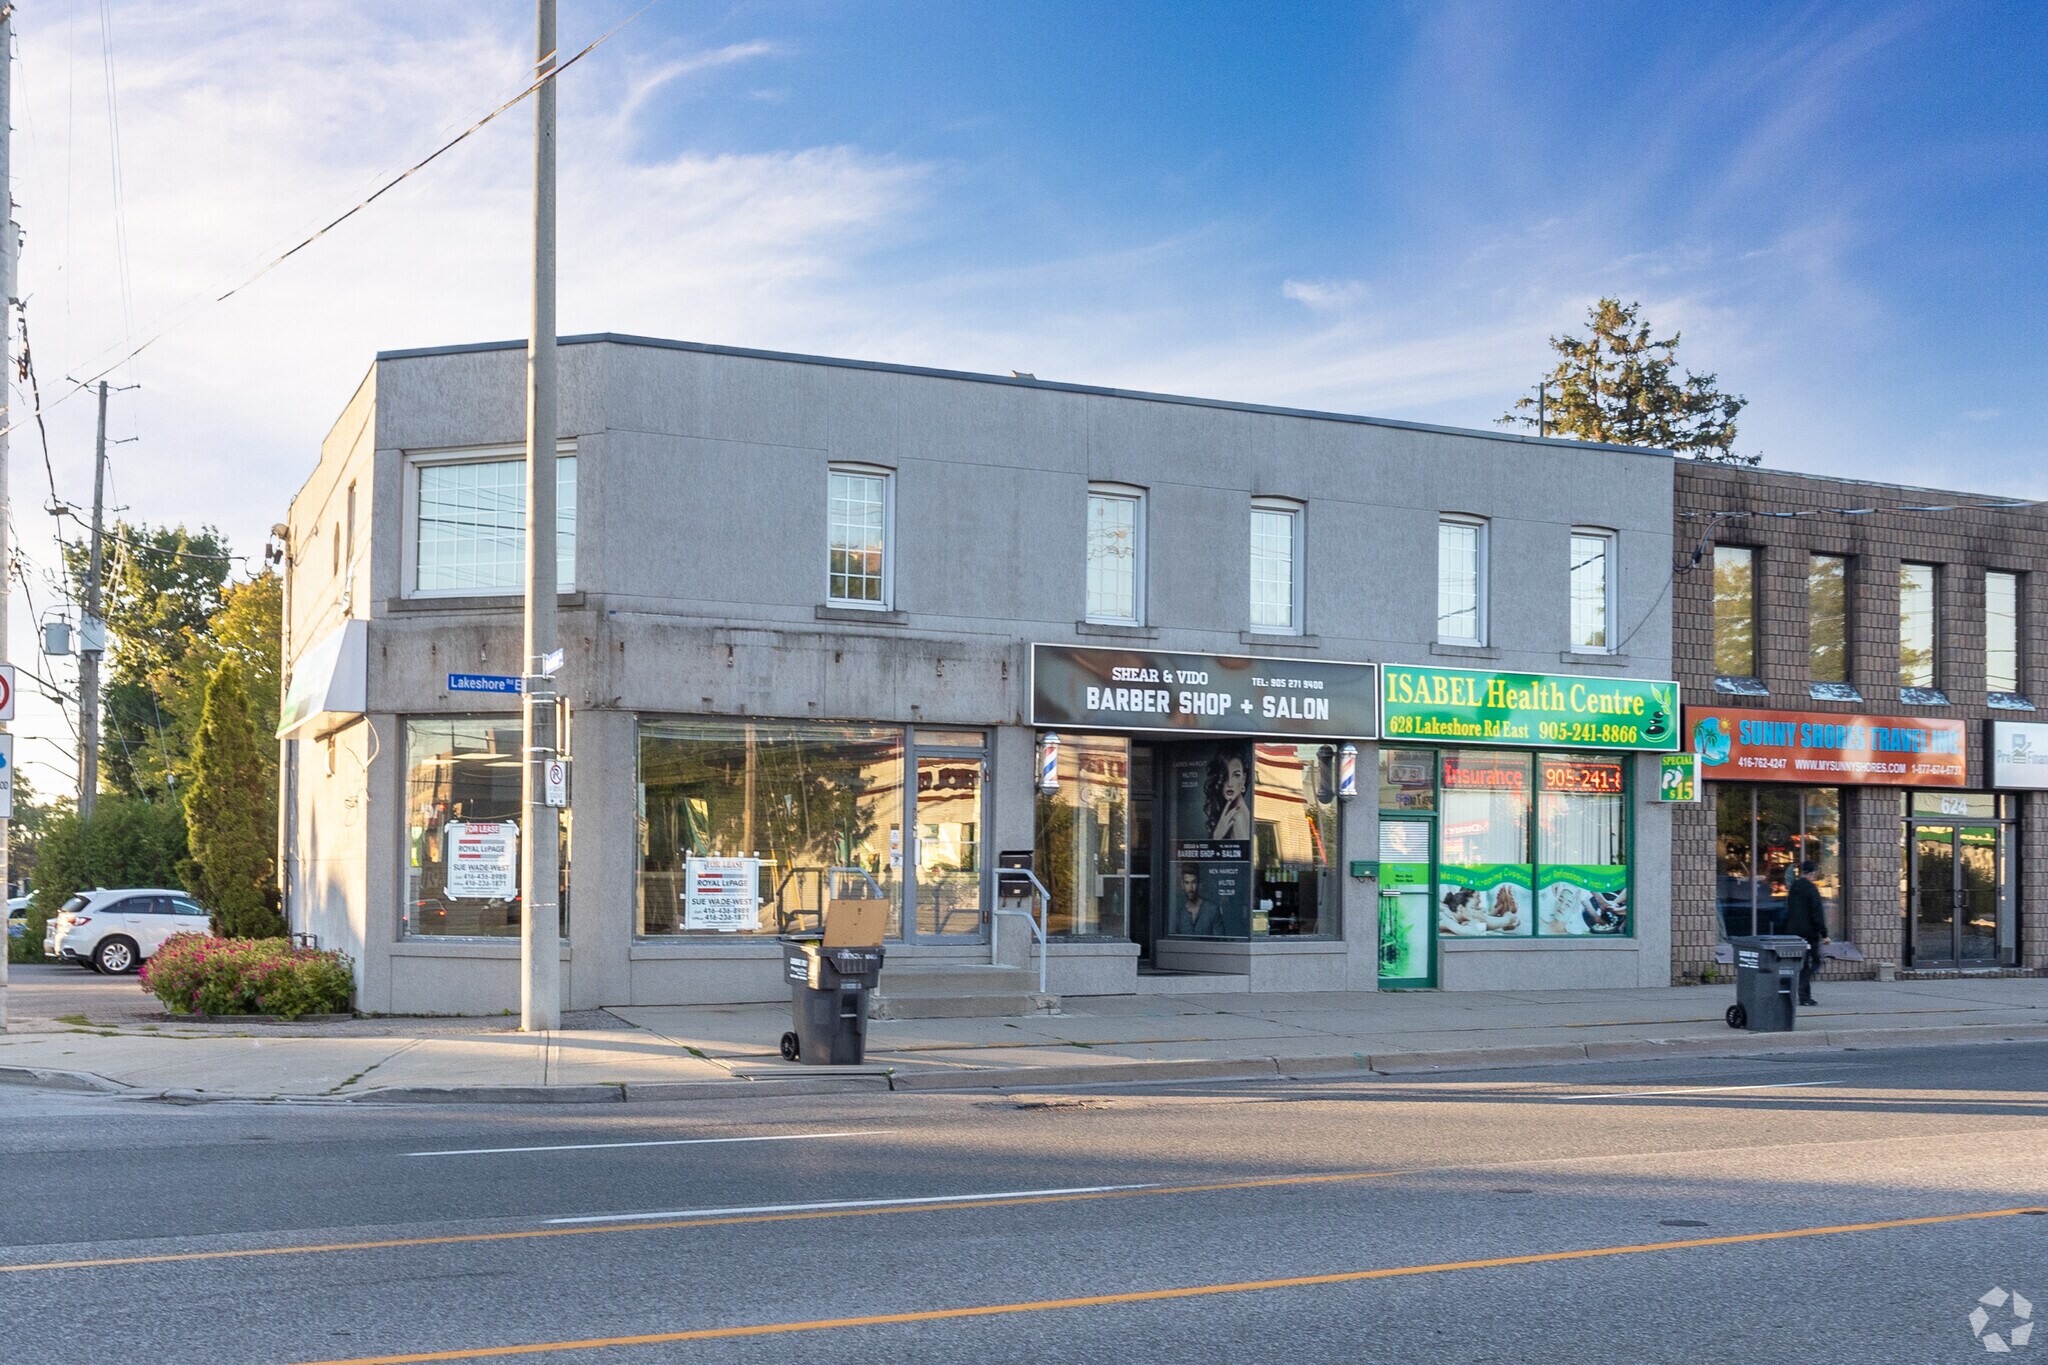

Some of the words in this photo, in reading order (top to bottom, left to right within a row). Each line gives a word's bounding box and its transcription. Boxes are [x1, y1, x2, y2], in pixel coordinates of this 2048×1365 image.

[450, 675, 505, 690] Lakeshore
[515, 679, 522, 690] E
[1112, 667, 1159, 683] SHEAR
[1163, 669, 1173, 684] &
[1176, 670, 1209, 686] VIDO
[1252, 677, 1269, 687] TEL:
[1270, 678, 1286, 688] 905
[1288, 679, 1301, 689] 271
[1303, 680, 1324, 690] 9400
[1387, 673, 1482, 707] ISABEL
[1487, 679, 1566, 712] Health
[1570, 683, 1645, 716] Centre
[1086, 686, 1170, 714] BARBER
[1179, 691, 1232, 716] SHOP
[1240, 699, 1254, 714] +
[1263, 696, 1329, 720] SALON
[1390, 716, 1413, 734] 628
[1415, 716, 1482, 736] Lakeshore
[1483, 719, 1500, 737] Rd
[1502, 720, 1529, 739] East
[1538, 721, 1638, 744] 905-241-8866
[1739, 719, 1798, 747] SUNNY
[1800, 722, 1866, 751] SHORES
[1871, 726, 1928, 754] TRAVEL
[1931, 729, 1963, 755] INC.
[1662, 756, 1694, 766] SPECIAL
[1738, 757, 1788, 769] 416-762-4247
[1794, 759, 1907, 774] WWW.MYSUNNYSHORES.COM
[1444, 762, 1523, 786] Insurance
[1940, 796, 1968, 815] 624
[465, 825, 479, 834] FOR
[479, 825, 500, 834] LEASE
[458, 845, 479, 853] ROYAL
[1200, 850, 1215, 858] SHOP
[1222, 850, 1242, 858] SALON
[453, 864, 467, 872] SUE
[706, 861, 721, 869] FOR
[722, 861, 744, 869] LEASE
[697, 879, 721, 887] ROYAL
[691, 898, 706, 906] SUE
